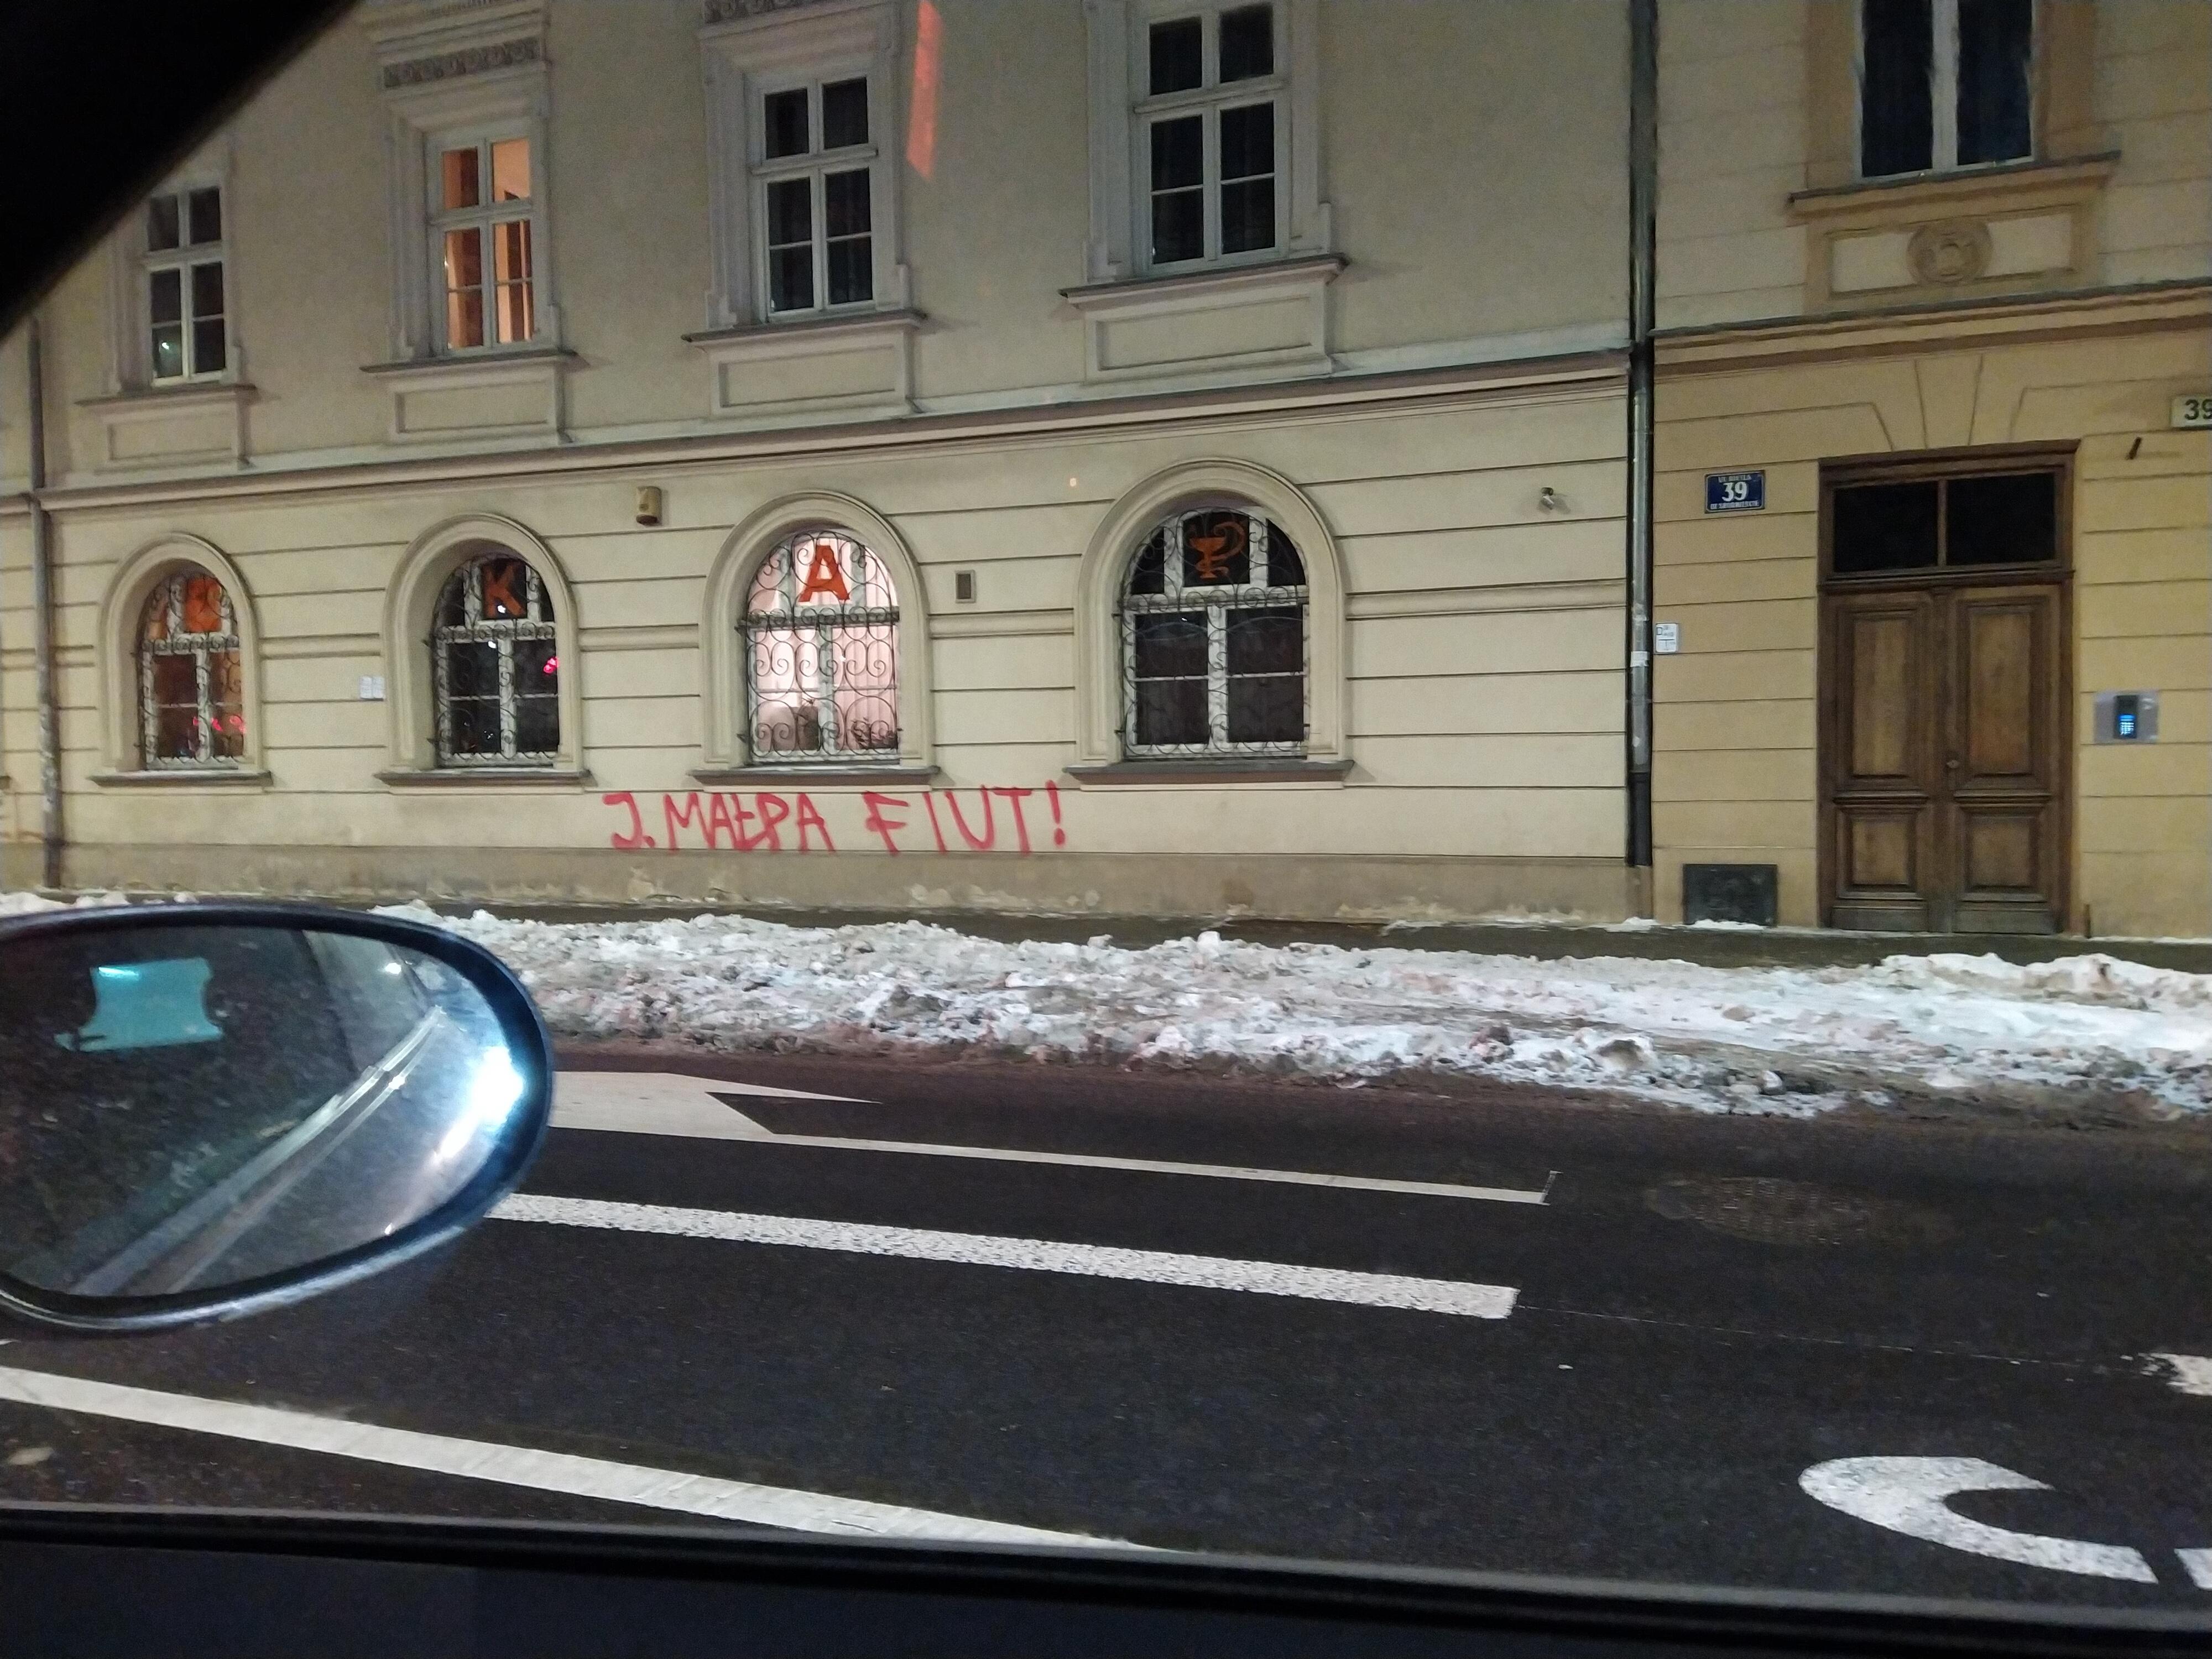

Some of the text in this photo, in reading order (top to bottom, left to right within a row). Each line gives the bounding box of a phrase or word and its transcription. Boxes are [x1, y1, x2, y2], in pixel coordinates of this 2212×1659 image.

[2184, 399, 2212, 420] 39
[1721, 482, 1747, 502] 39
[798, 545, 851, 603] A
[603, 791, 655, 852] J.
[863, 780, 1066, 857] FIUT!
